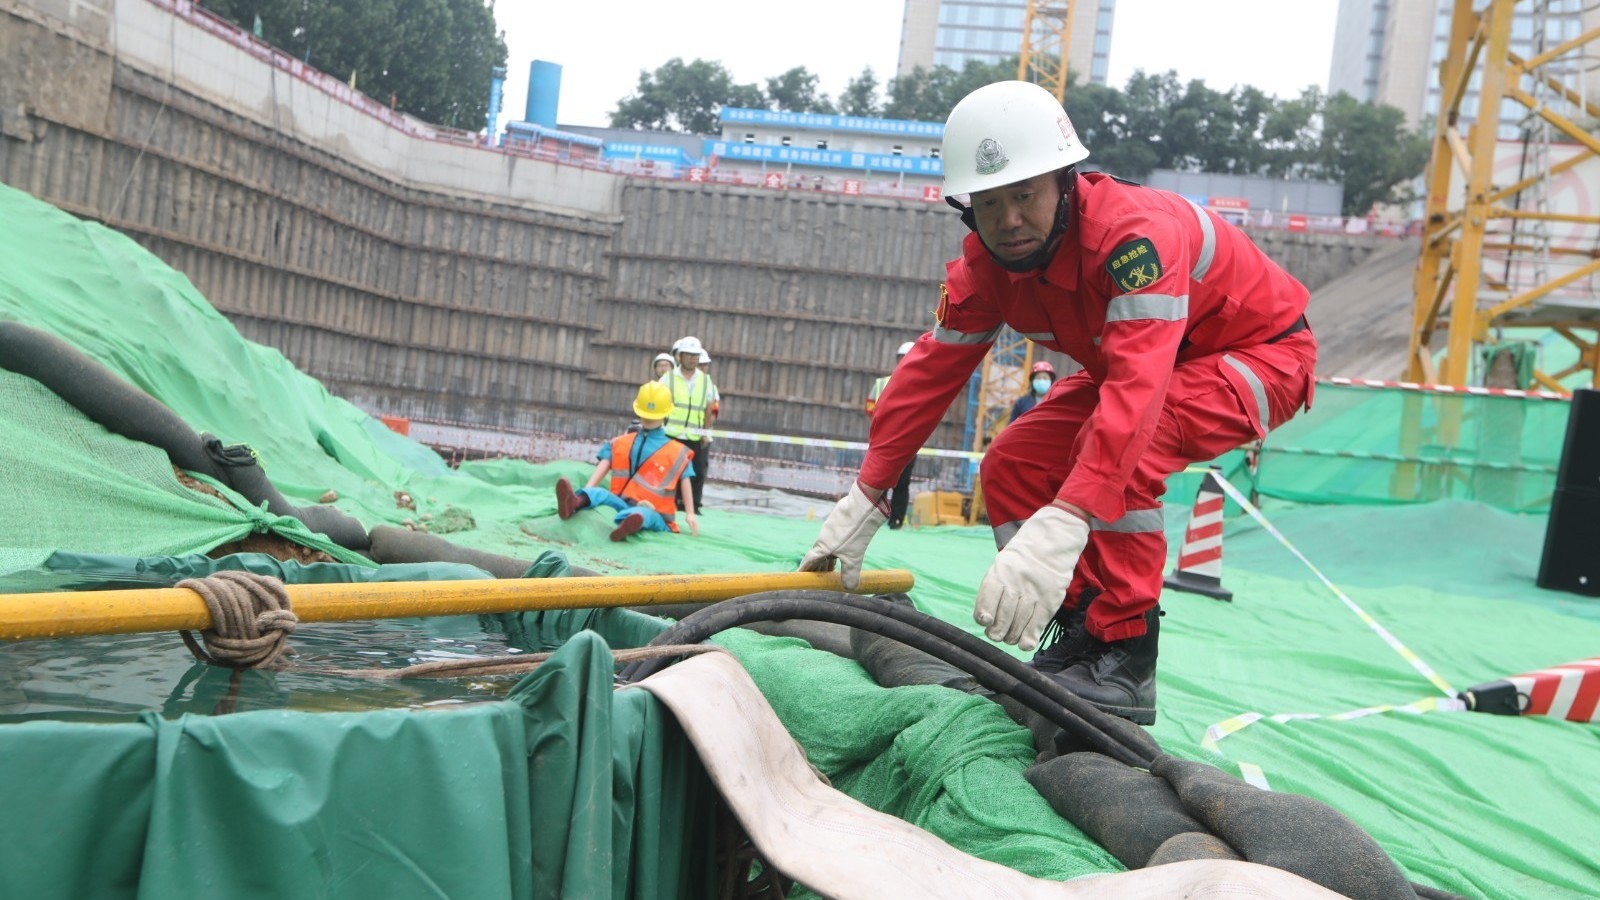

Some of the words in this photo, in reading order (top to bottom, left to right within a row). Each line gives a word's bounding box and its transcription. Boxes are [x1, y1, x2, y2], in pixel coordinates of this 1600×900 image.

[690, 168, 703, 182] 安
[767, 174, 781, 188] 全
[1111, 244, 1148, 270] 应急抢险
